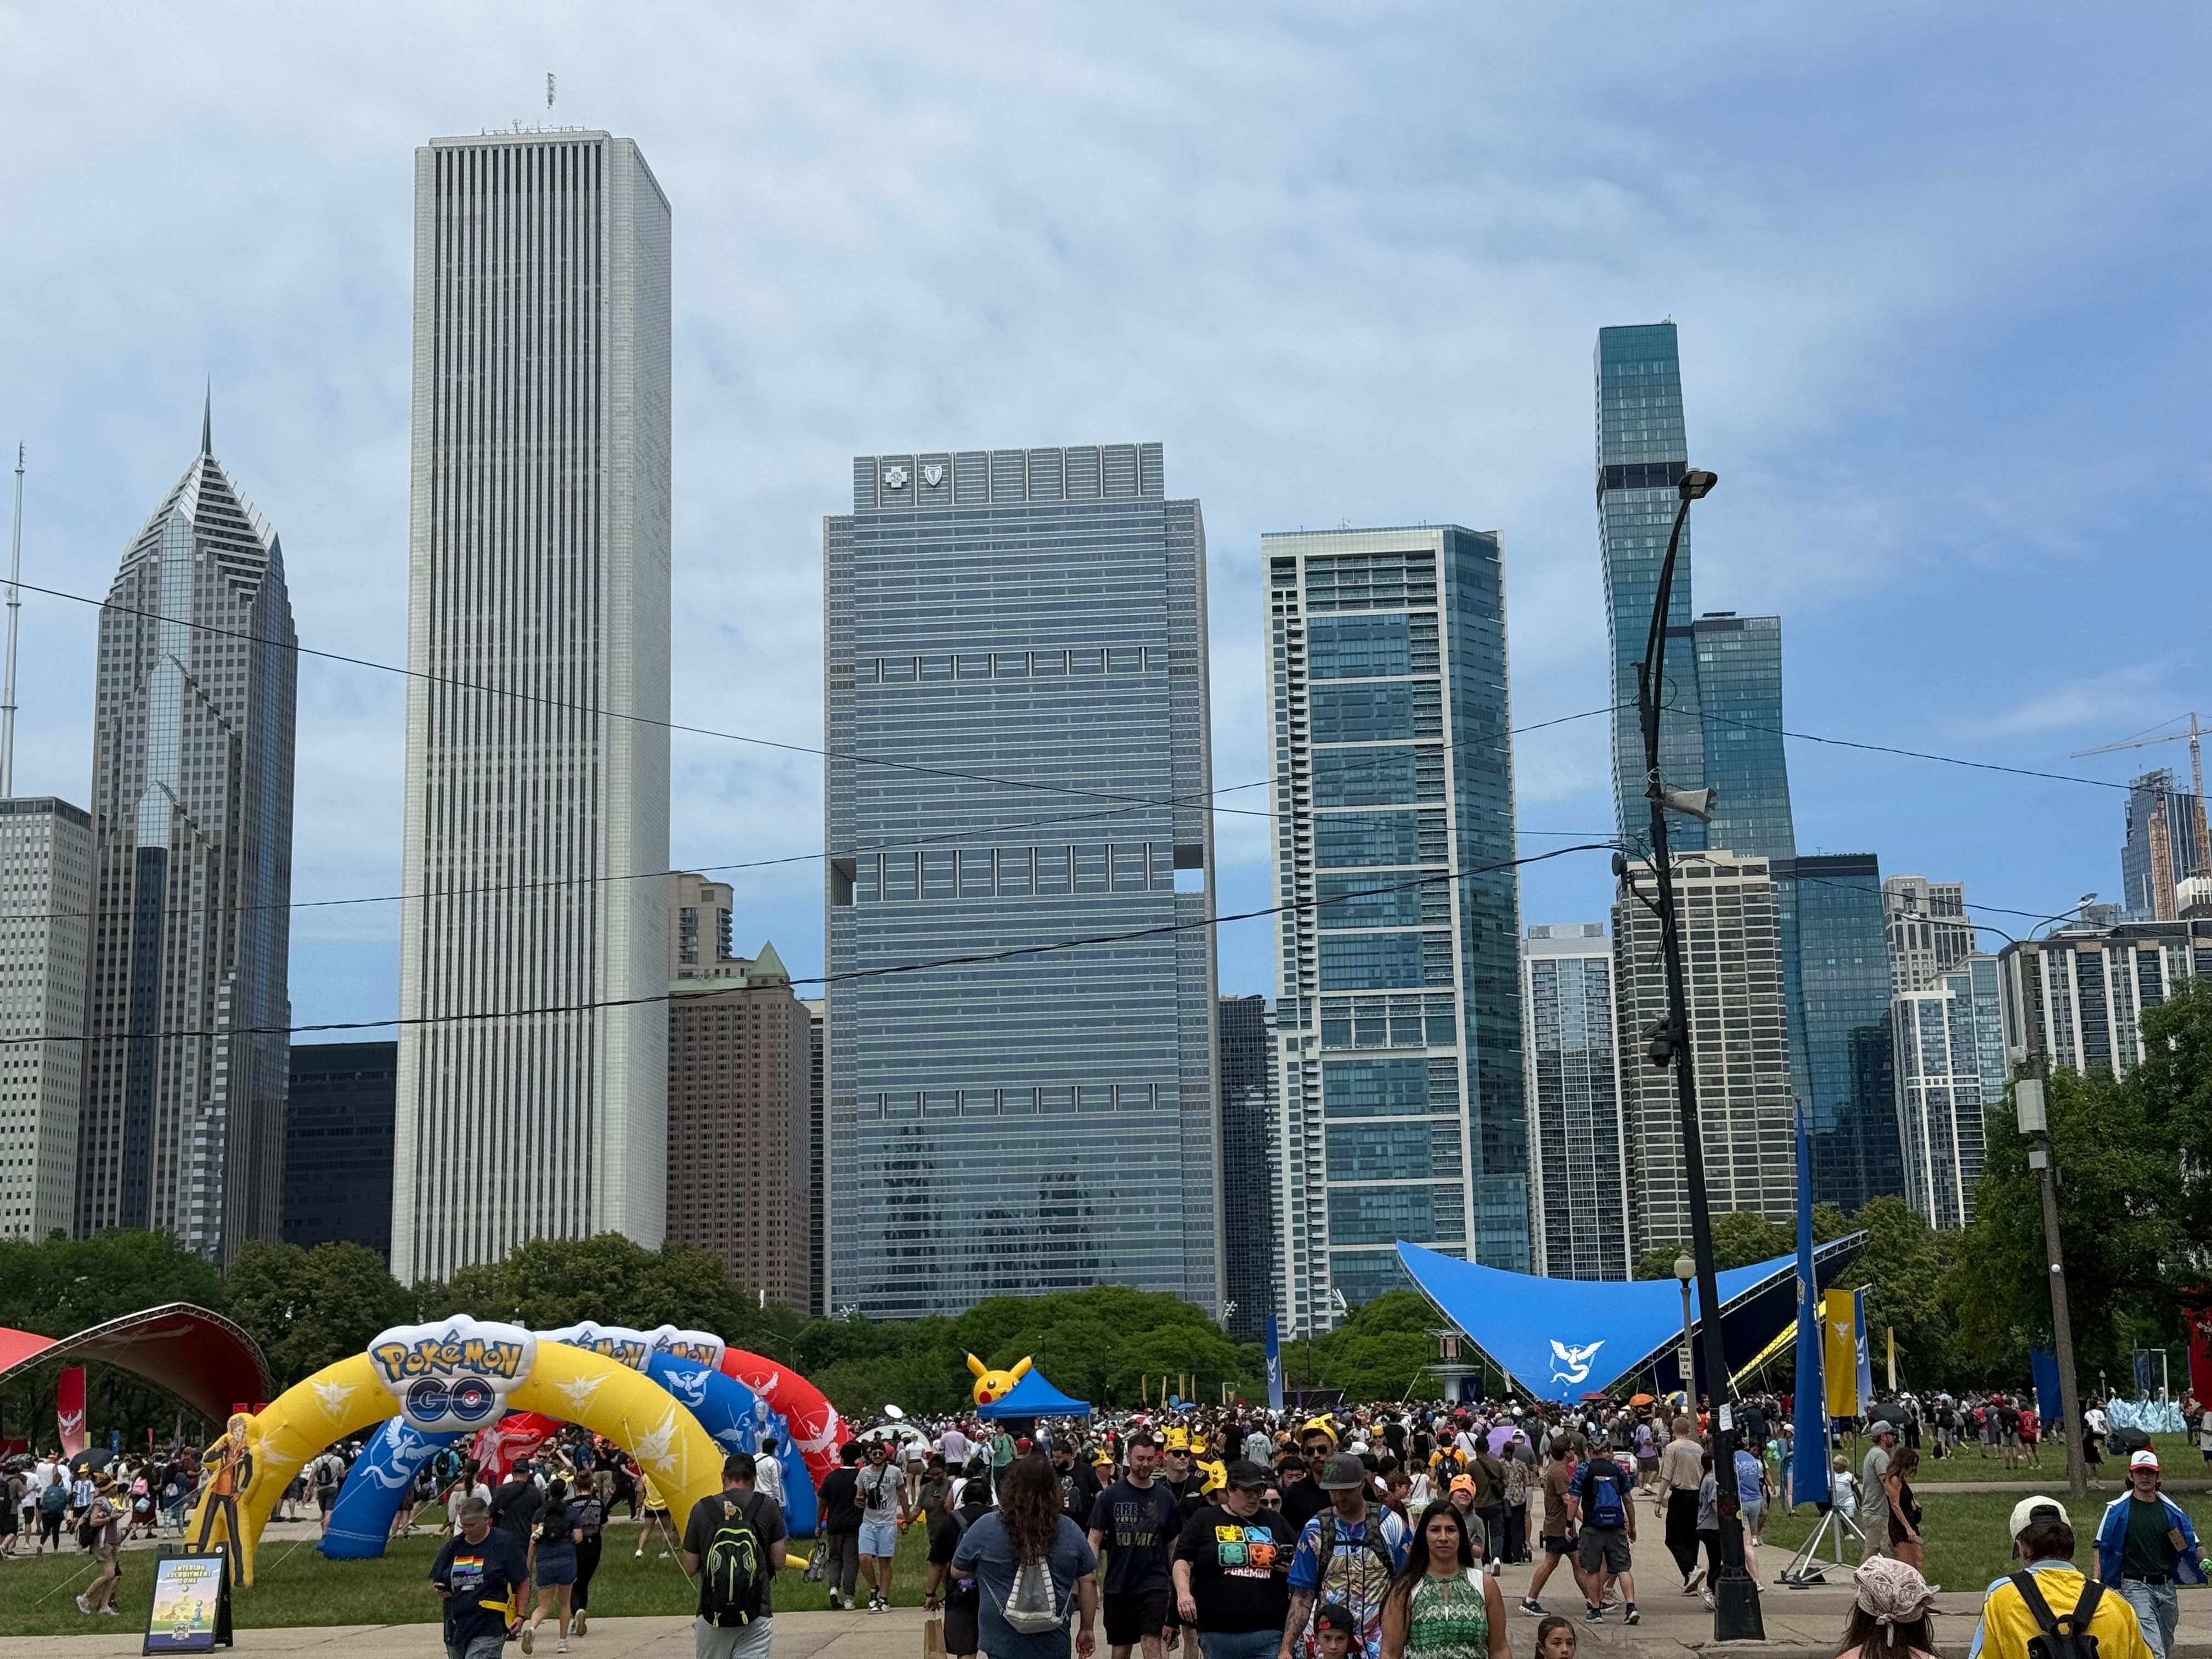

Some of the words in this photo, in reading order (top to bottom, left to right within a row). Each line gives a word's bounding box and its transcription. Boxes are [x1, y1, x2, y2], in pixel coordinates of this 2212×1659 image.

[407, 1377, 495, 1422] GO
[1113, 1502, 1138, 1516] ARE
[1116, 1532, 1131, 1546] TO
